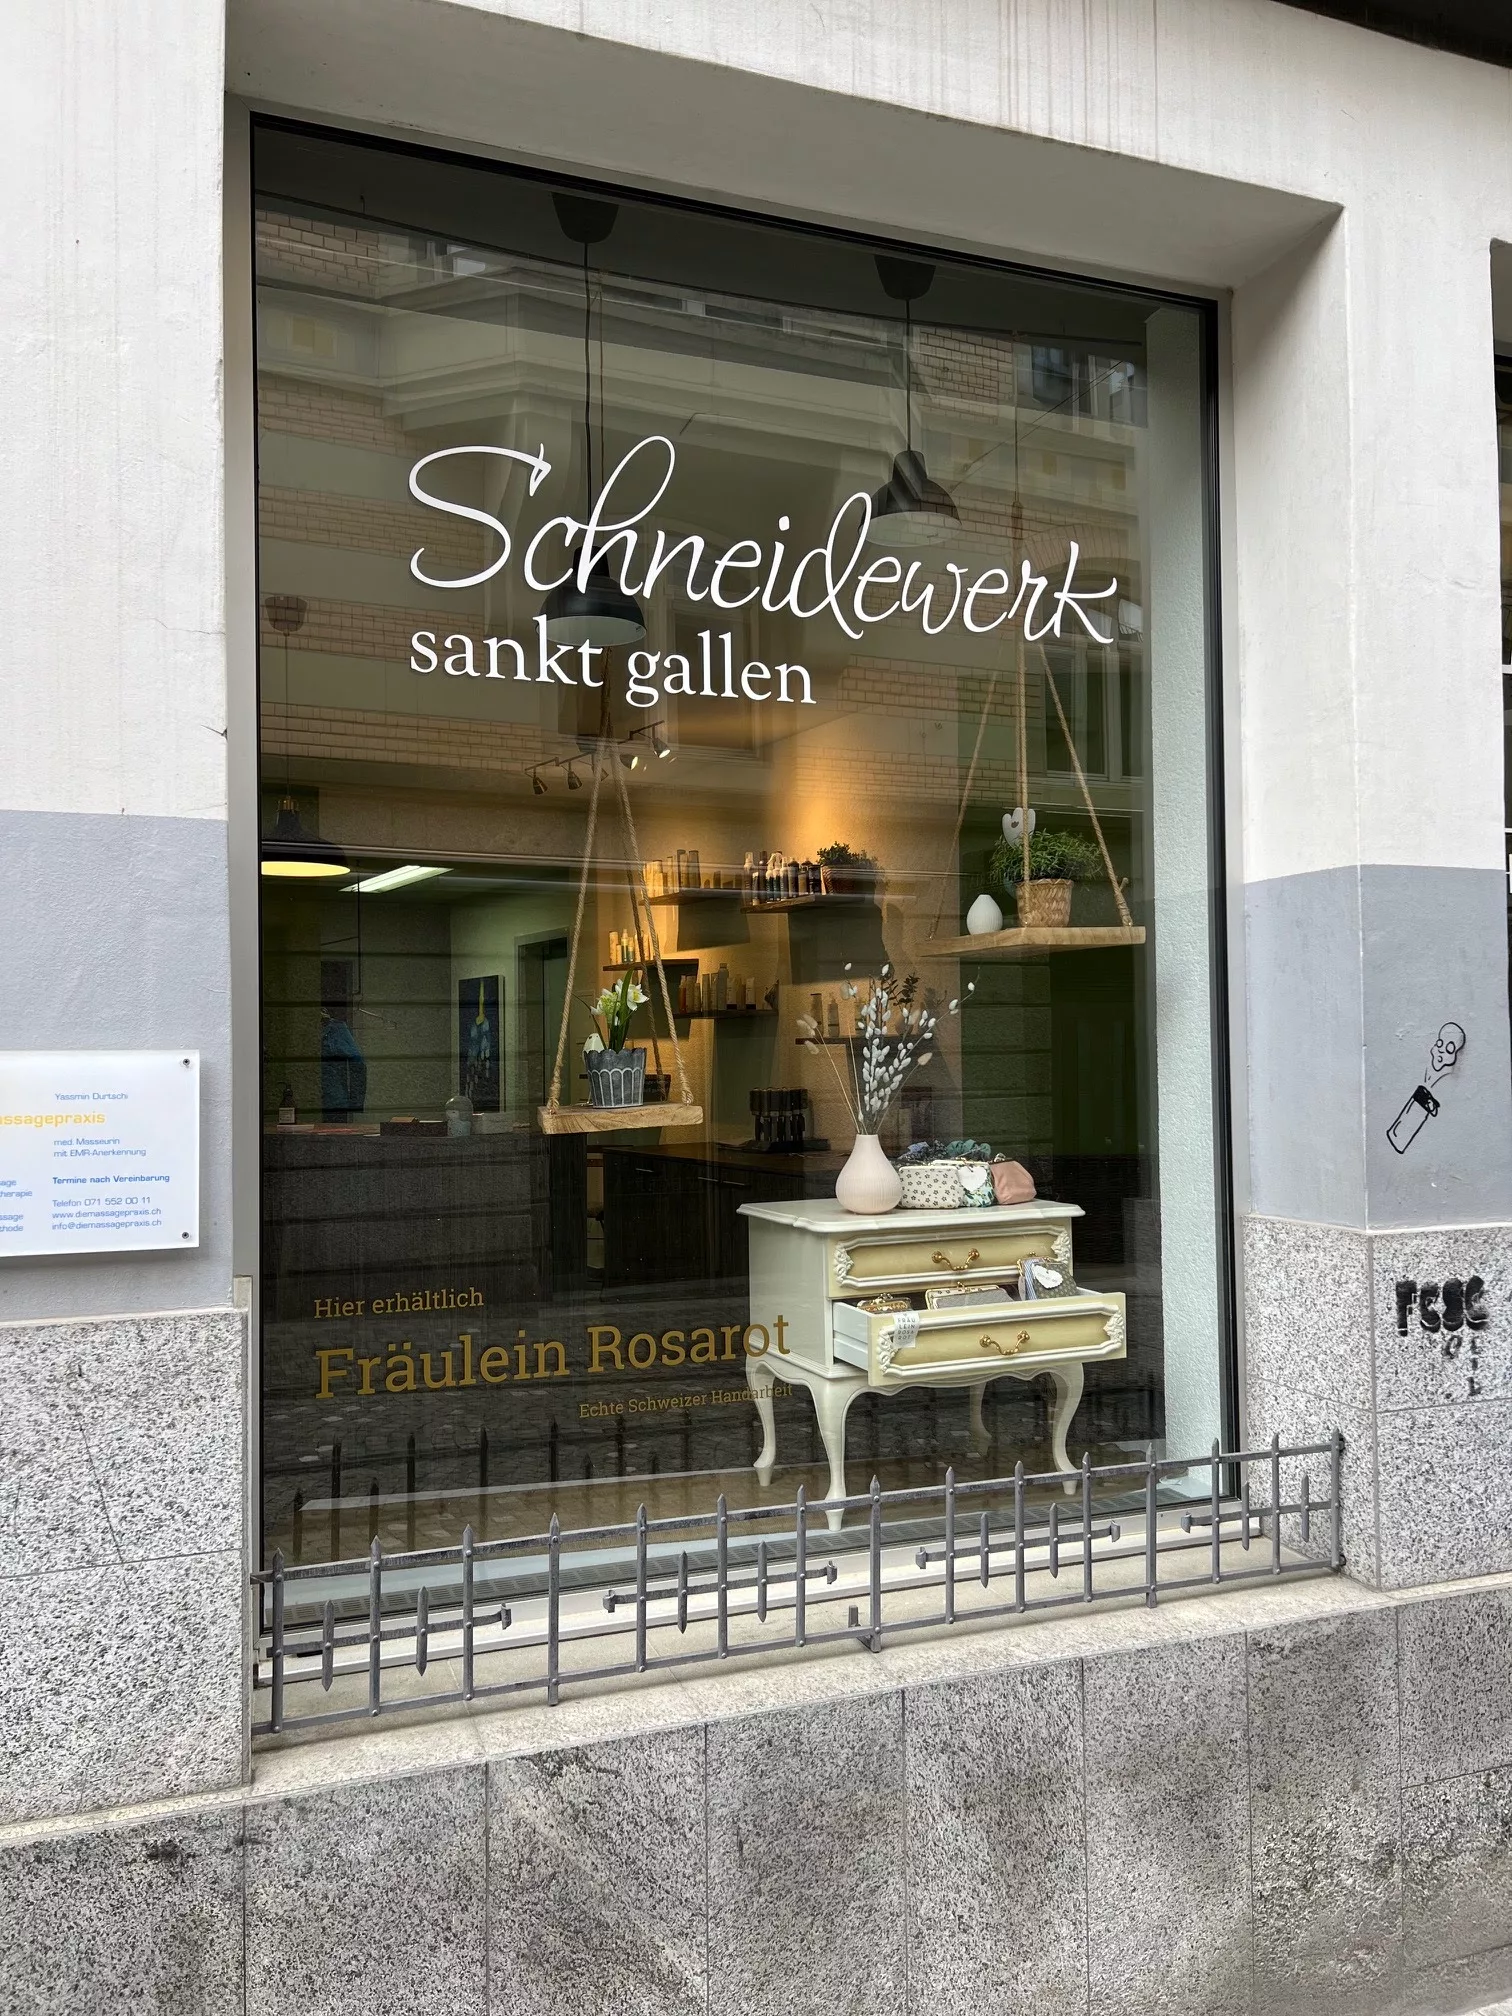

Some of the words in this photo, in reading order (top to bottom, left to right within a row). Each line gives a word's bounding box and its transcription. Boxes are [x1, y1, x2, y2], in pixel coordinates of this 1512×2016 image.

[408, 435, 1119, 644] Schneidewerk
[409, 615, 604, 688] sankt
[625, 631, 818, 708] gallen
[76, 1137, 120, 1145] Masseurin
[69, 1148, 147, 1157] EMR-Anerkennung
[52, 1176, 87, 1184] Termine
[89, 1175, 111, 1183] nach
[113, 1174, 170, 1183] Vereinbarung
[105, 1198, 122, 1206] 552
[52, 1208, 161, 1218] www.diemassagepraxis.ch
[52, 1219, 162, 1230] info@diemassagepraxis.ch
[313, 1299, 365, 1319] Hier
[371, 1287, 485, 1315] erhältlich
[315, 1329, 570, 1399] Fräulein
[586, 1314, 792, 1373] Rosarot
[579, 1403, 625, 1419] Echte
[628, 1392, 708, 1412] Schweizer
[711, 1382, 794, 1406] Handarbeit
